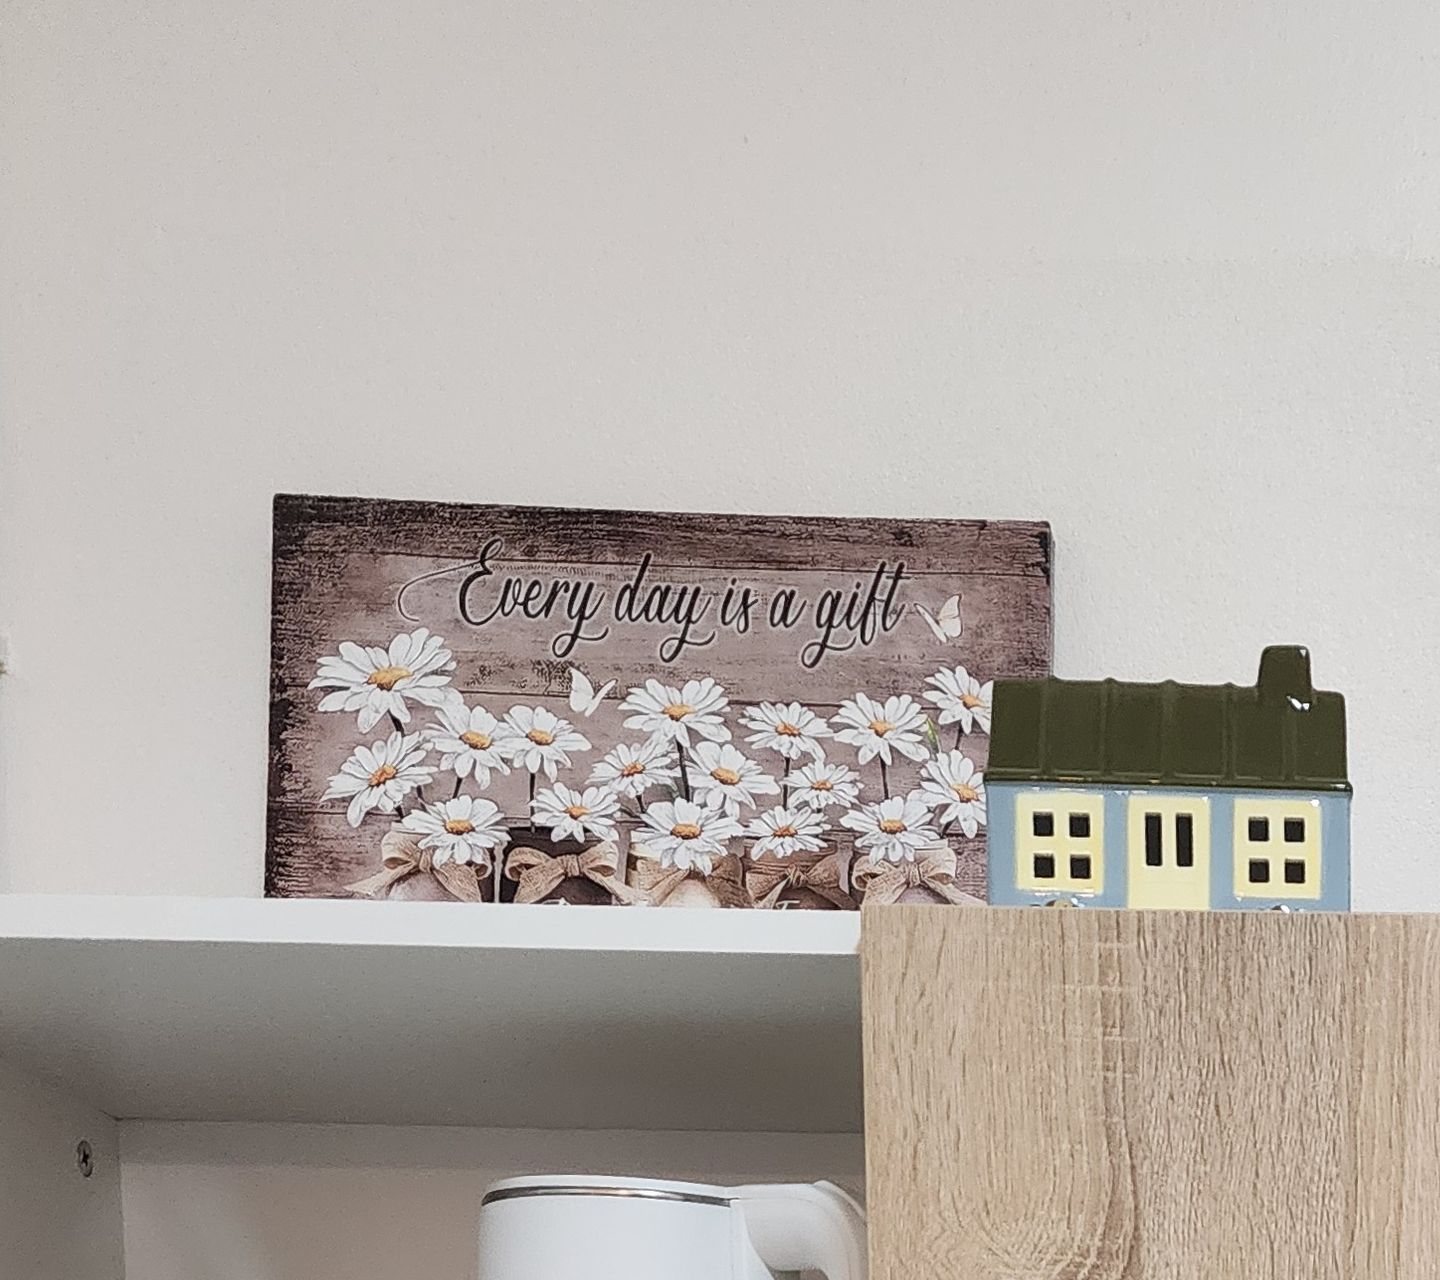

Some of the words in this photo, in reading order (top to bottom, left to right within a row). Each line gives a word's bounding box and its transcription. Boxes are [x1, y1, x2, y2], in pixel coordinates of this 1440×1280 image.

[397, 538, 608, 659] Every
[614, 553, 716, 663] day
[720, 577, 758, 634] is
[769, 587, 807, 628] a
[802, 560, 910, 669] gift
